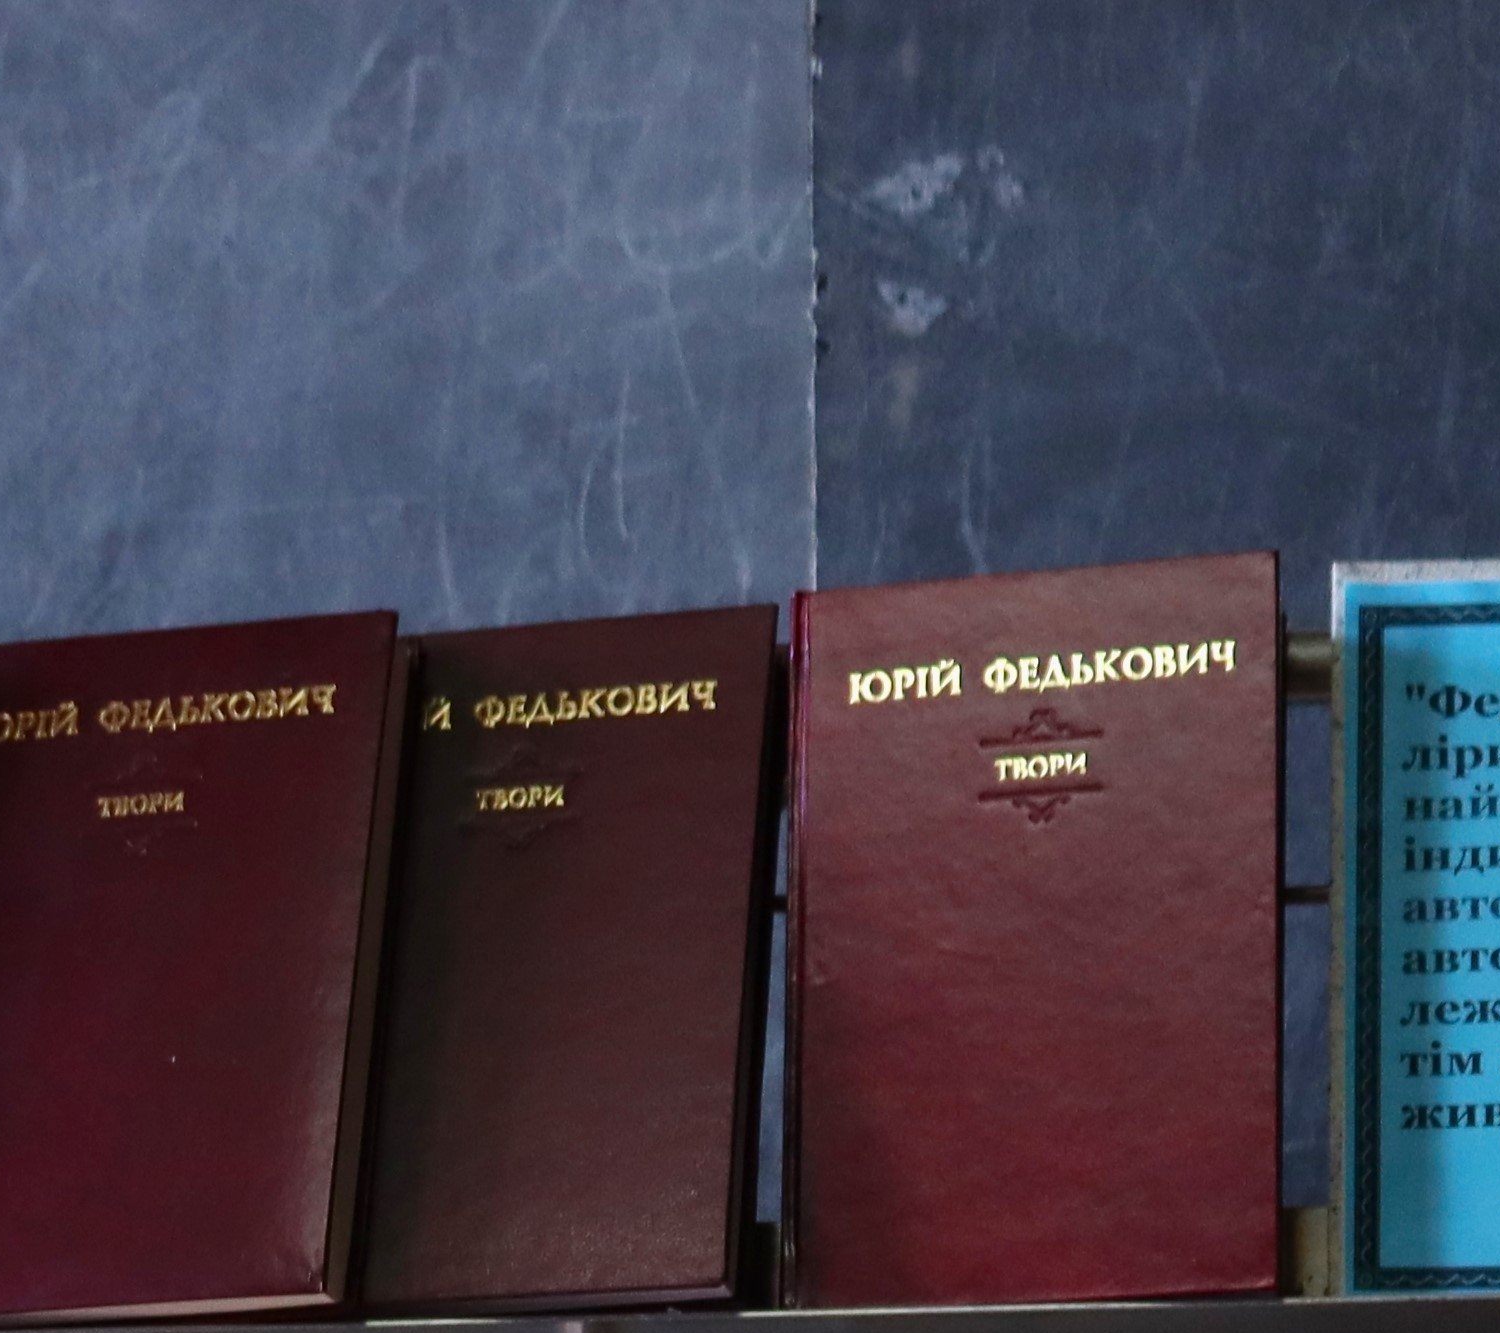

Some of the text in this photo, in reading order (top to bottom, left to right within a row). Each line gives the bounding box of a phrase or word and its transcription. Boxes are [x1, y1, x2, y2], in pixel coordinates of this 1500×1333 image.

[848, 639, 1237, 705] ЮРІЙ ФЕДЬКОВИЧ
[98, 683, 337, 733] ФЕДЬКОВИЧ
[473, 679, 718, 729] ФЕДЬКОВИЧ
[994, 752, 1088, 783] ТВОРИ
[97, 791, 185, 818] ТВОРИ
[476, 785, 564, 812] ТВОРИ
[1401, 1041, 1482, 1078] тім
